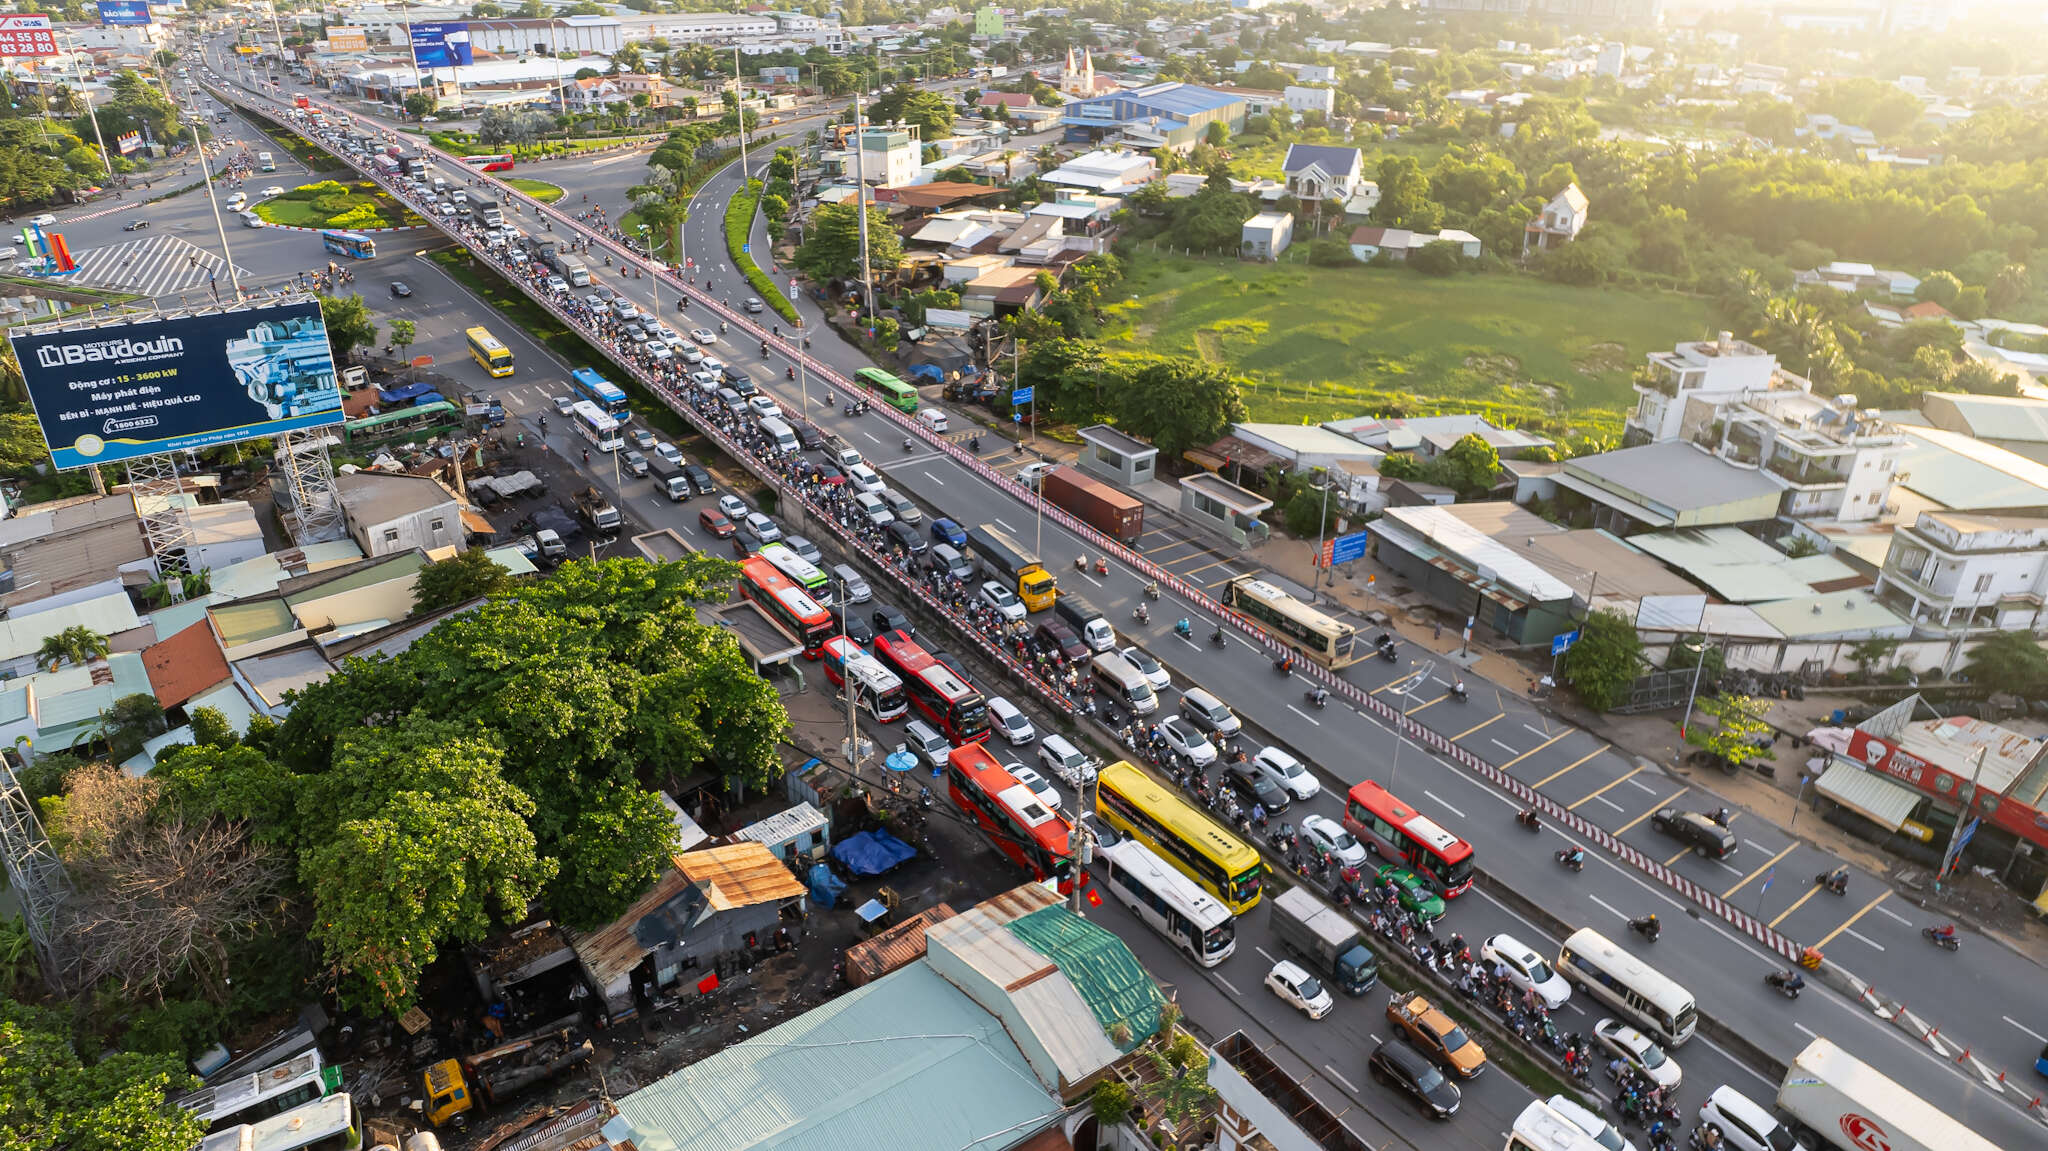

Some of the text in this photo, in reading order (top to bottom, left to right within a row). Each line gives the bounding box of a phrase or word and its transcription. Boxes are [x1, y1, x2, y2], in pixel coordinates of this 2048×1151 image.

[16, 32, 32, 42] 55
[34, 32, 50, 41] 88
[1, 43, 54, 53] 83 28 80
[84, 340, 123, 349] MOTEURS
[62, 336, 184, 364] Baudouin
[148, 352, 184, 361] COMPANY
[68, 380, 97, 390] Động
[98, 378, 111, 386] cơ
[136, 371, 161, 381] 3600
[161, 368, 178, 377] kW
[91, 386, 161, 402] Máy phát điện
[95, 406, 123, 416] MẠNH
[142, 398, 163, 409] HIỆU
[164, 396, 182, 406] QUẢ
[183, 394, 201, 402] CAO
[114, 421, 133, 429] 1800
